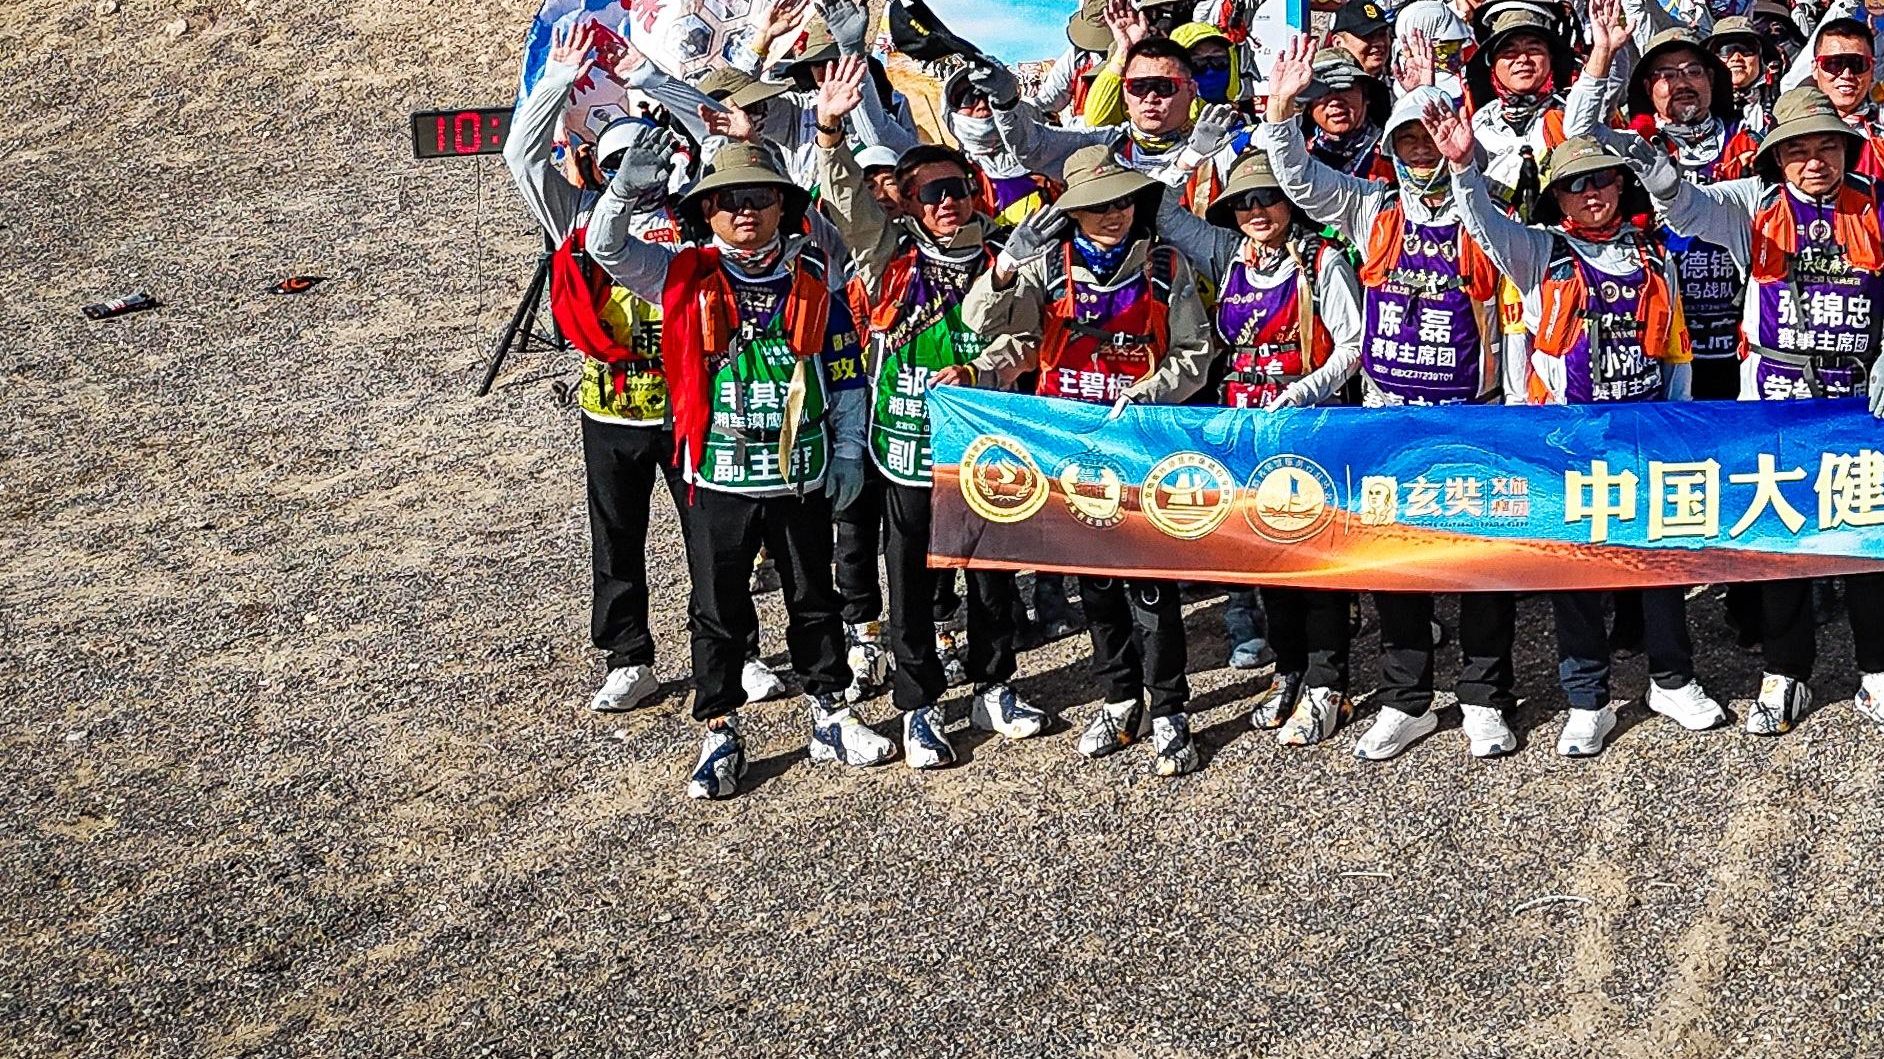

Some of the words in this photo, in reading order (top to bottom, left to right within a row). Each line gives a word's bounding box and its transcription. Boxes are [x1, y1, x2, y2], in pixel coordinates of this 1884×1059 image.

[1370, 336, 1457, 368] 赛事主席团
